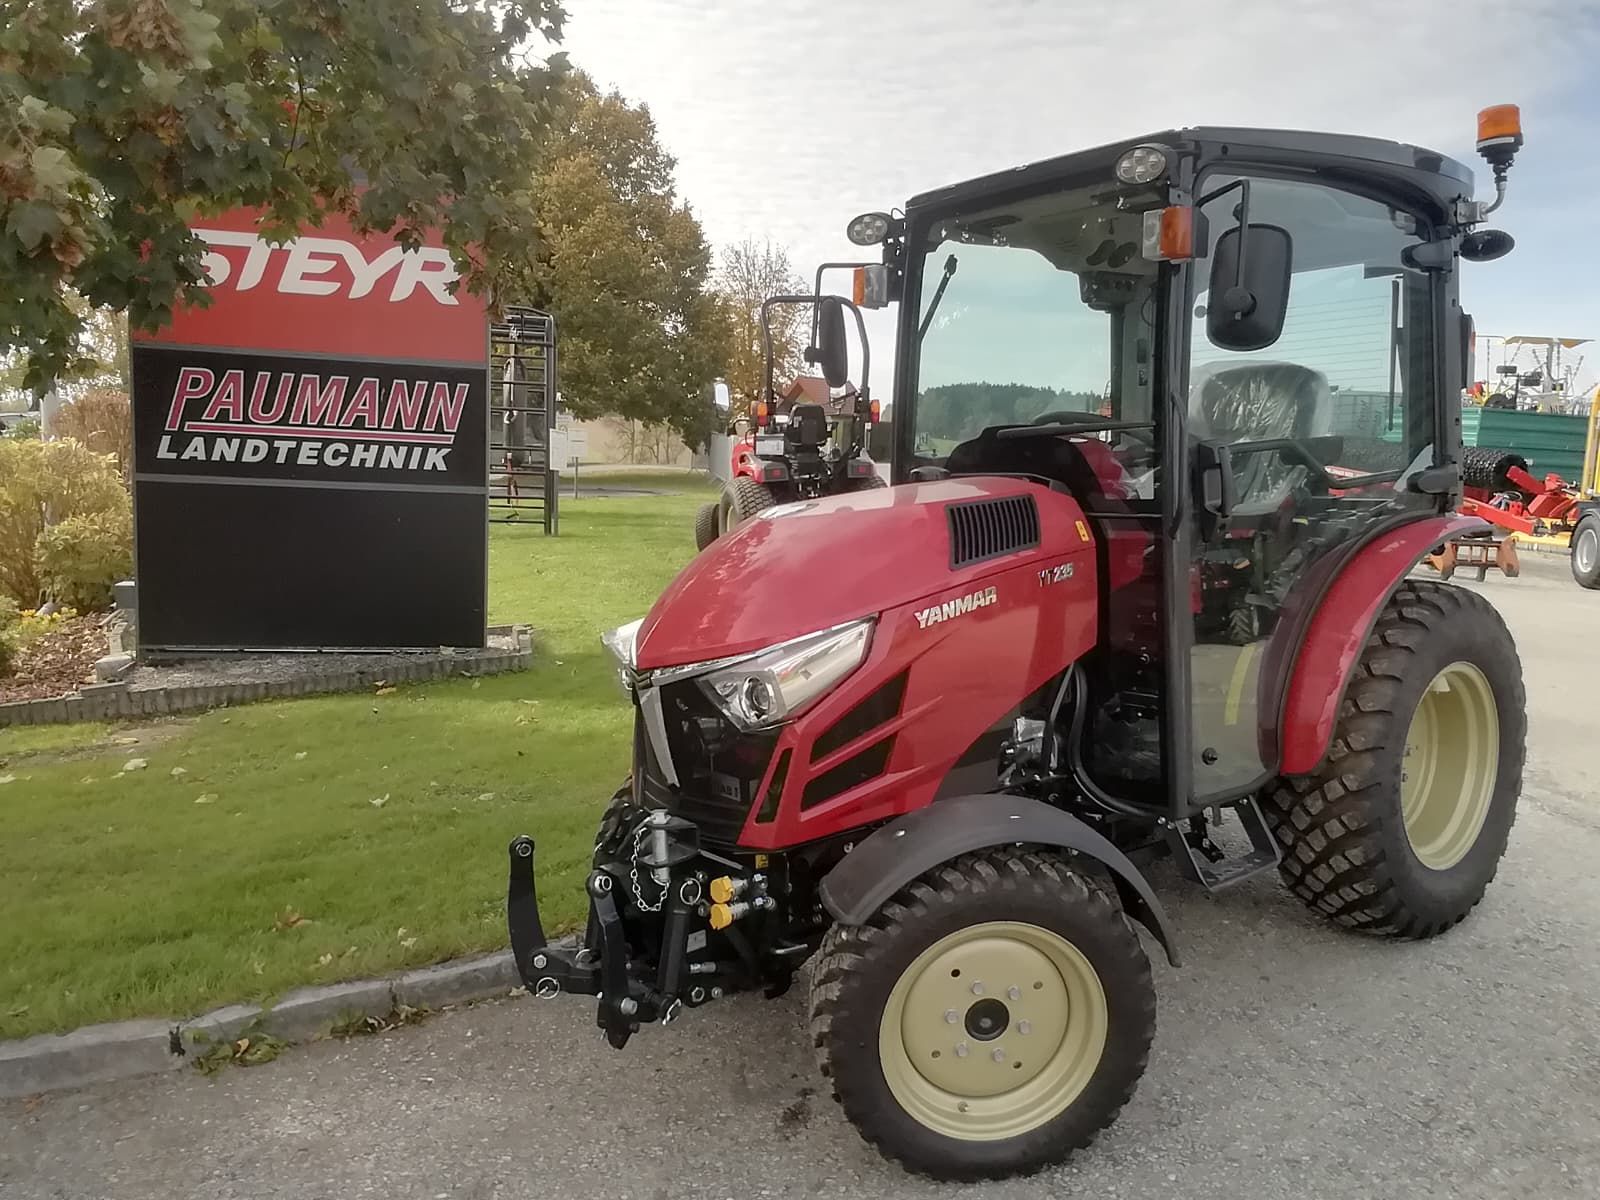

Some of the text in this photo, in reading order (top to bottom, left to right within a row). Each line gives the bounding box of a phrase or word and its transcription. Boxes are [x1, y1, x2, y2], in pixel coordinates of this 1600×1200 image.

[190, 229, 460, 305] STEYR
[164, 367, 470, 433] PAUMANN
[157, 435, 452, 471] LANDTECHNIK
[914, 586, 997, 629] YANMAR
